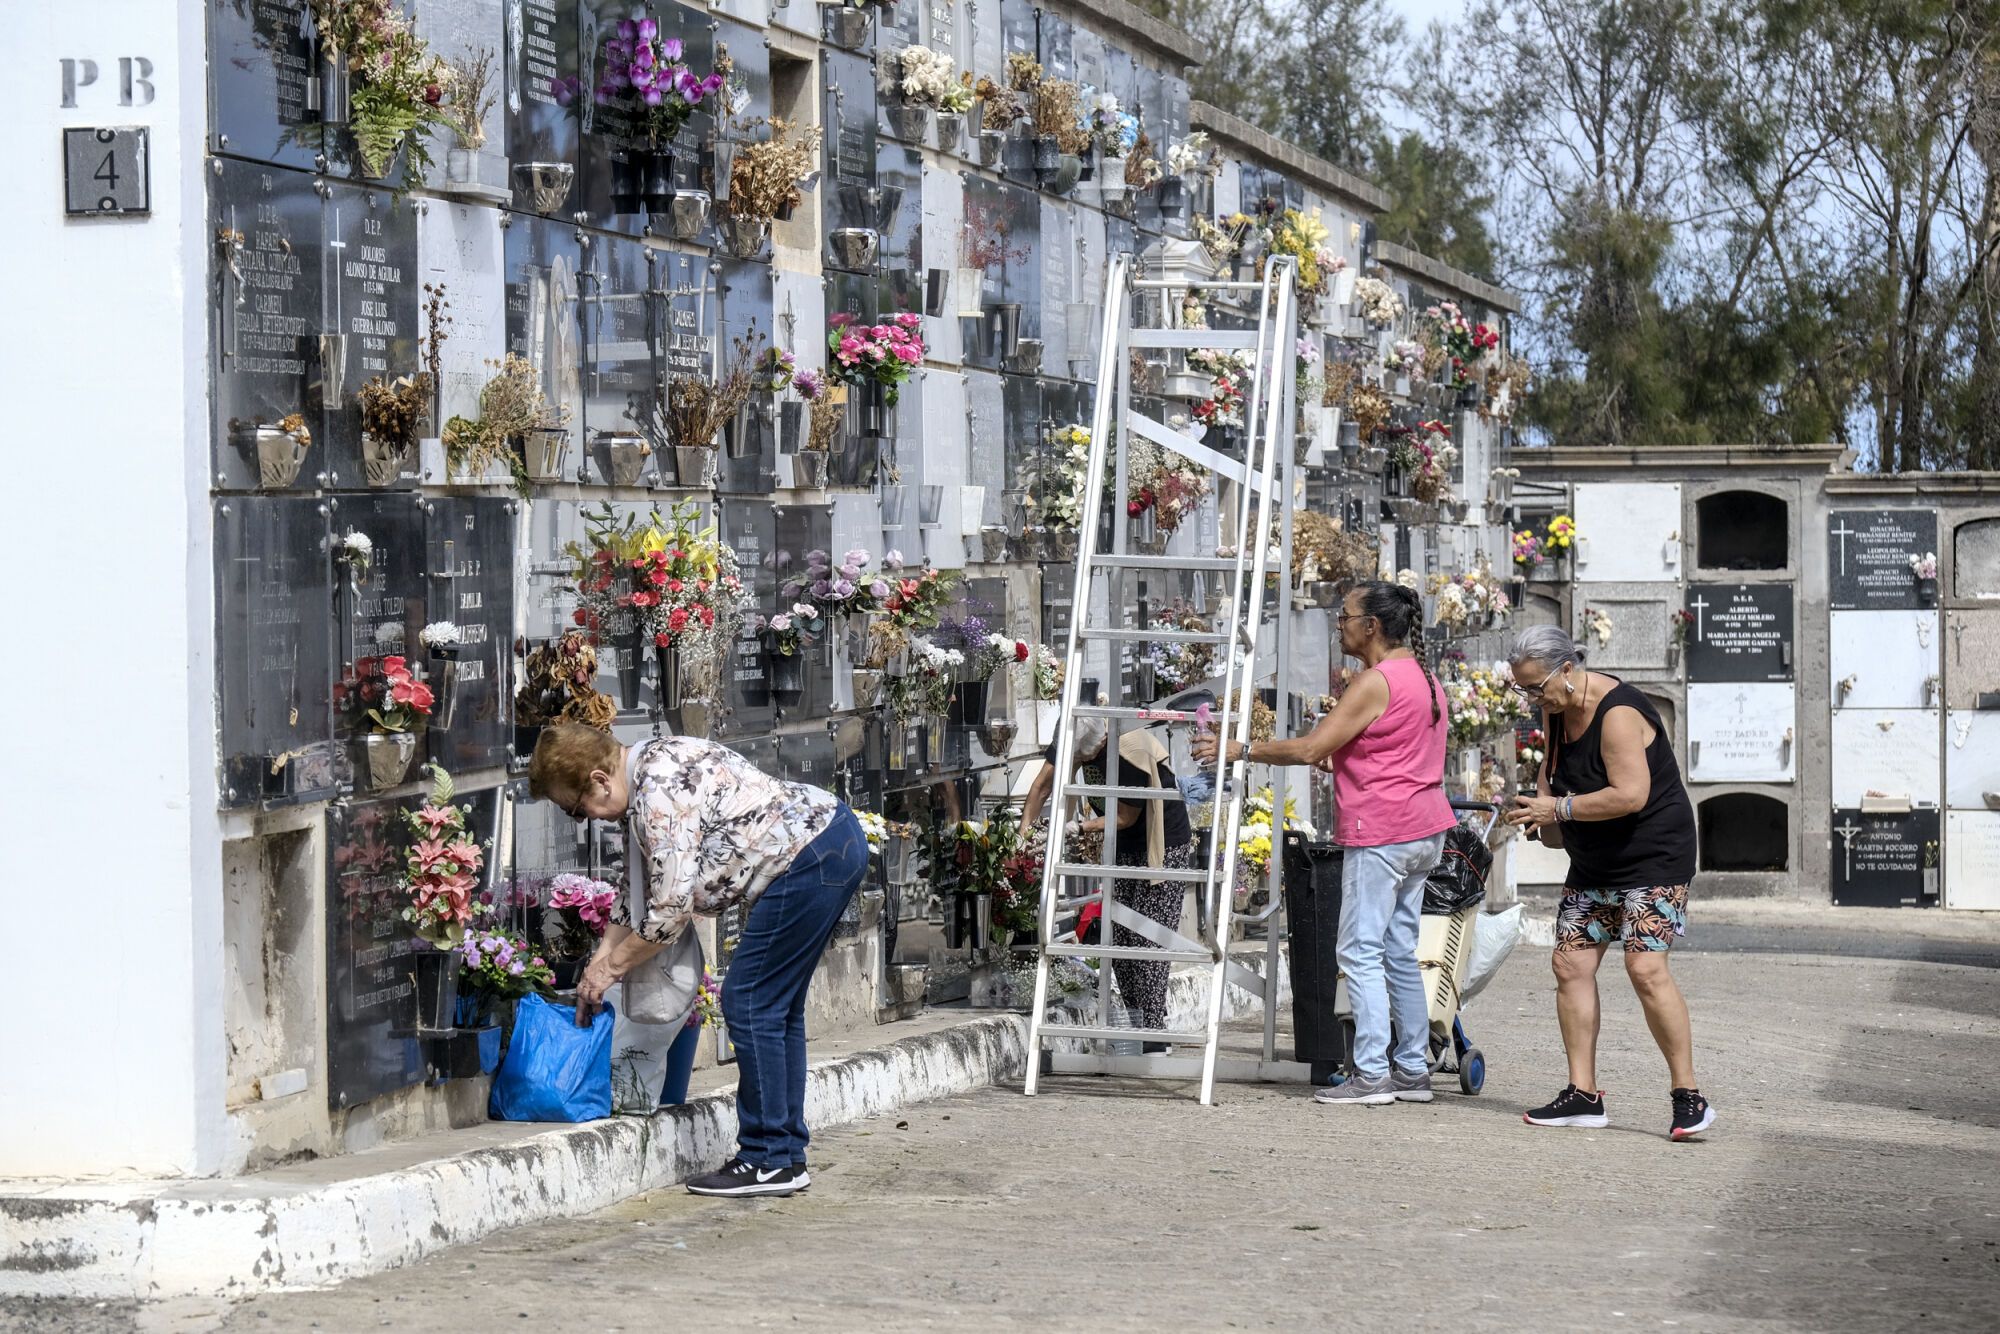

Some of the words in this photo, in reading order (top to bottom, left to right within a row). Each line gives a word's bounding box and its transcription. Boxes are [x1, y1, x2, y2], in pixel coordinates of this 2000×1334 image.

[59, 58, 99, 108] P
[118, 57, 155, 107] B
[94, 149, 119, 190] 4
[361, 245, 385, 263] DOLORES
[346, 261, 368, 278] ALONSO
[369, 264, 376, 279] DE
[377, 265, 400, 283] AGUILAR
[255, 294, 282, 314] CARMEN
[361, 300, 373, 316] JOSE
[375, 302, 387, 317] LUIS
[262, 315, 306, 336] BETHENCOURT
[352, 317, 374, 334] GUERRA
[375, 320, 396, 336] ALONSO
[369, 357, 386, 371] FAMILIA
